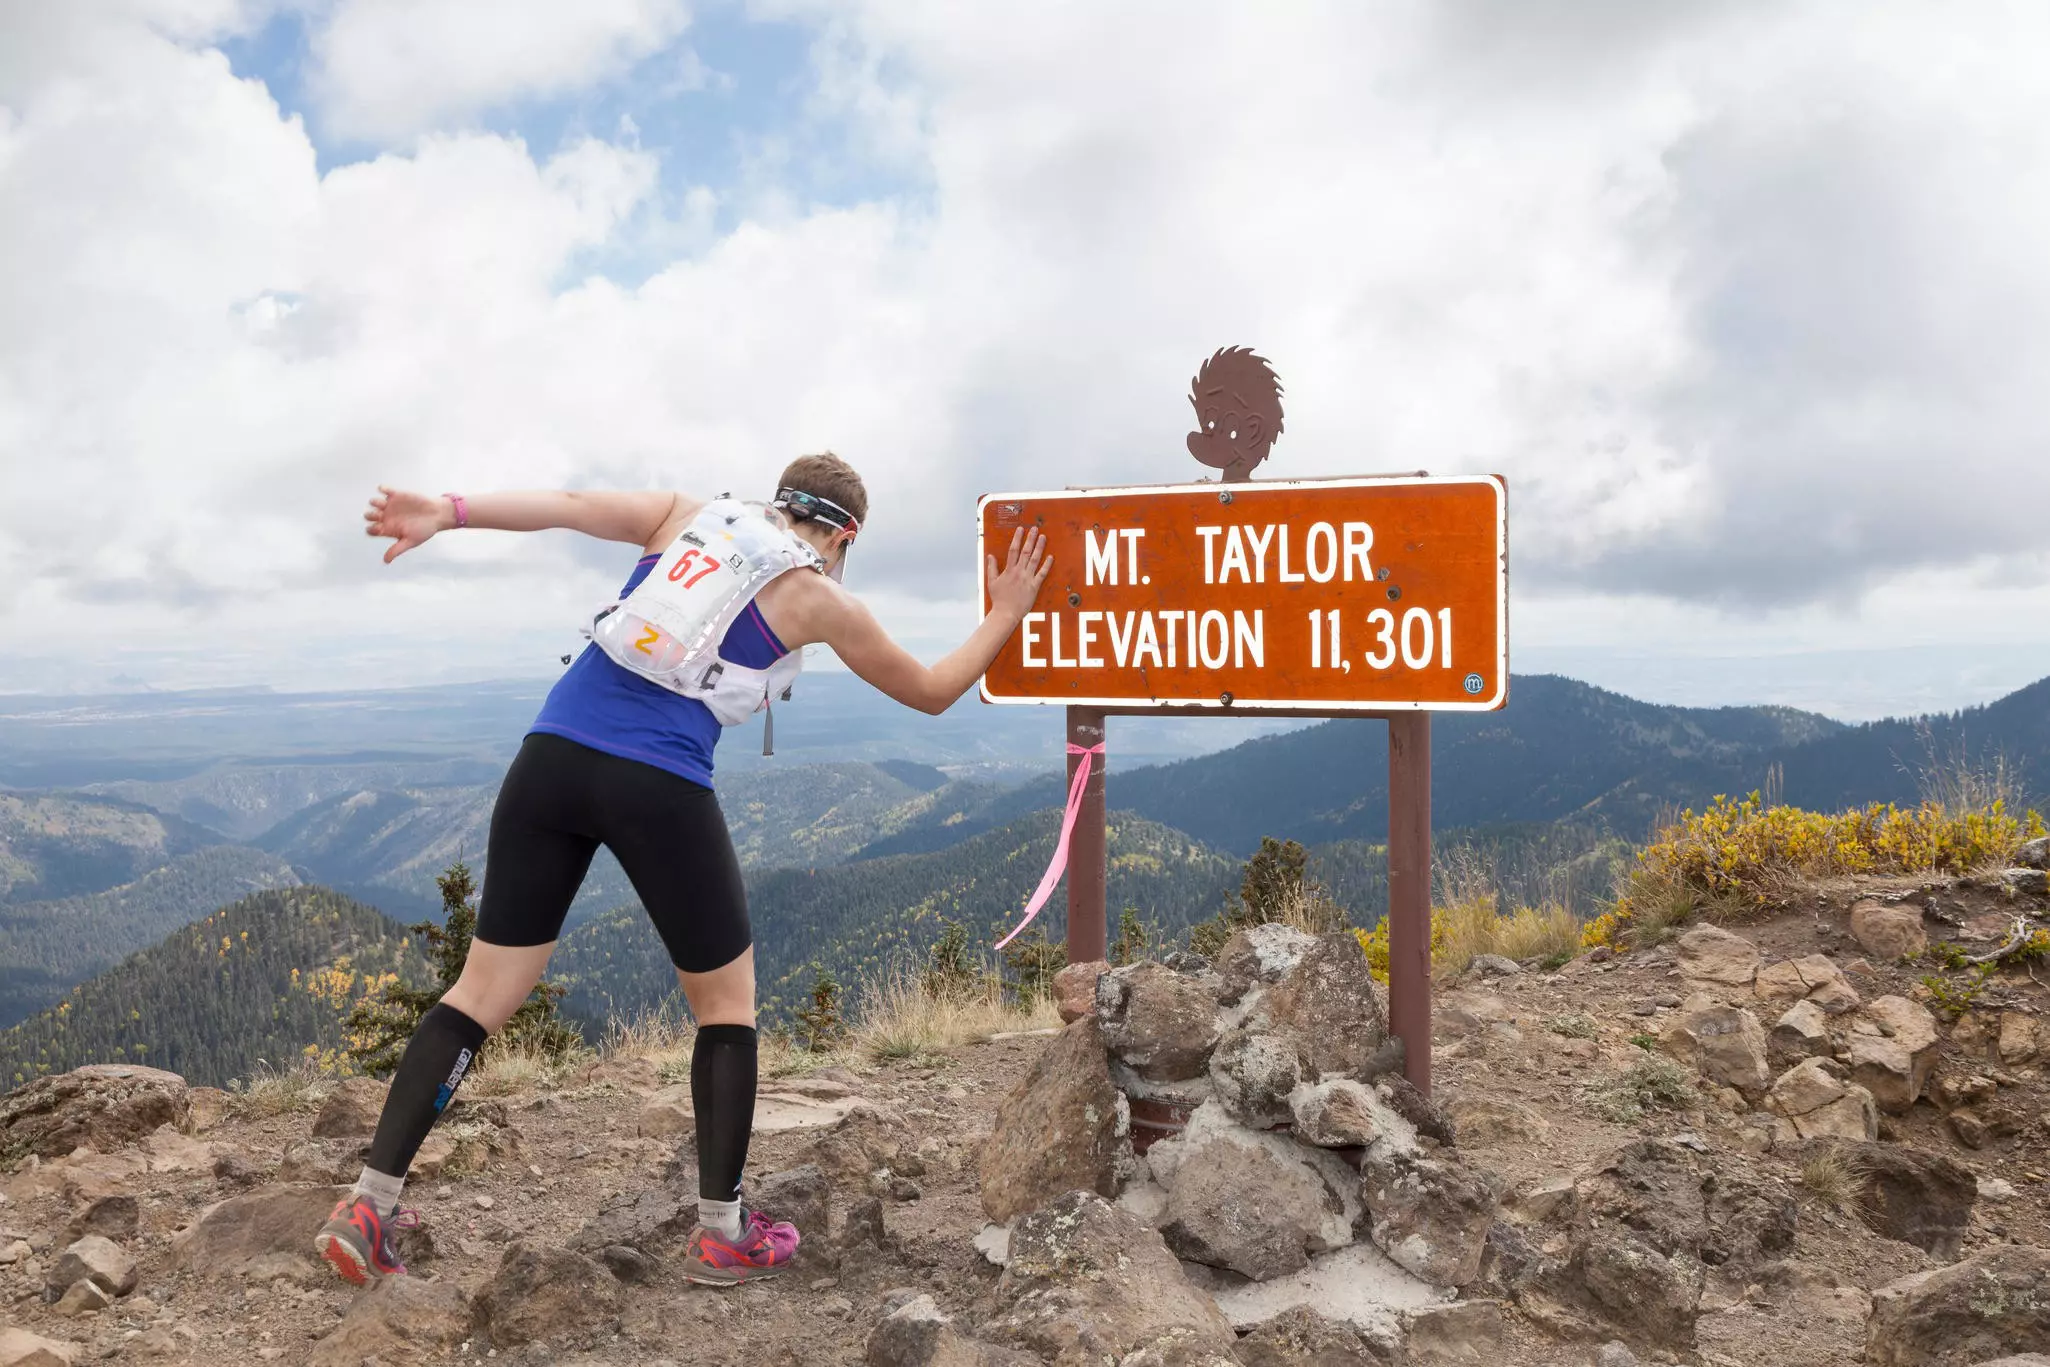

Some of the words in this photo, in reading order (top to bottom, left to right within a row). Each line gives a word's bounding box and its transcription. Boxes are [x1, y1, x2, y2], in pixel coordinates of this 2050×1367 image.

[667, 549, 721, 590] 67
[1084, 527, 1151, 586] MT.
[1195, 521, 1374, 585] TAYLOR
[1022, 609, 1265, 670] ELEVATION
[1308, 606, 1452, 674] 11,301
